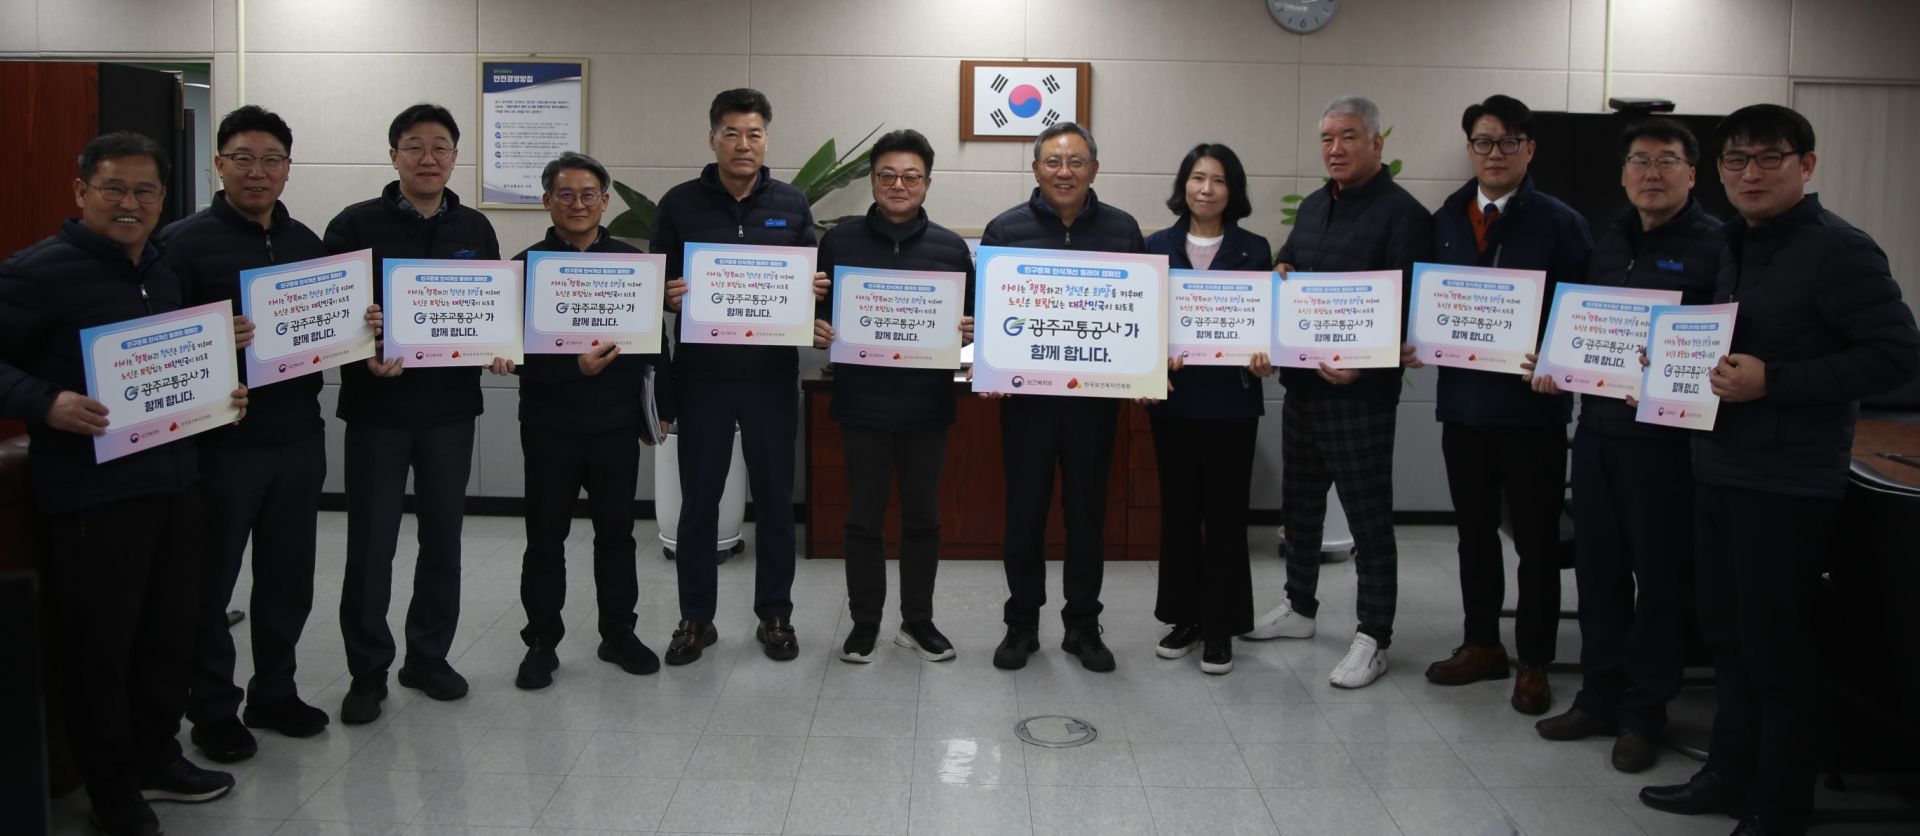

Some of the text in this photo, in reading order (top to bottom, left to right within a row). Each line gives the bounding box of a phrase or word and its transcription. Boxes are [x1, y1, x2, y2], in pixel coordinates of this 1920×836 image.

[1001, 282, 1143, 298] 아이는 행복하고! 청년은 희망을 키우며!
[725, 293, 788, 305] 광주교통공사 가
[1008, 296, 1134, 312] 노인은 보람있는 대한민국이 되도록
[570, 302, 635, 314] 광주교통공사 가
[726, 307, 743, 316] 함께
[290, 308, 349, 332] 광주교통공사 가
[428, 312, 494, 324] 광주교통공사 가
[572, 317, 589, 326] 함께
[926, 320, 935, 328] 가
[292, 327, 336, 346] 함께 합니다.
[430, 327, 478, 337] 함께 합니다.
[1027, 318, 1139, 340] 광주교통공사 가
[1030, 344, 1111, 363] 함께 합니다.
[140, 367, 209, 396] 광주교통공사 가
[144, 389, 195, 412] 함께 합니다.
